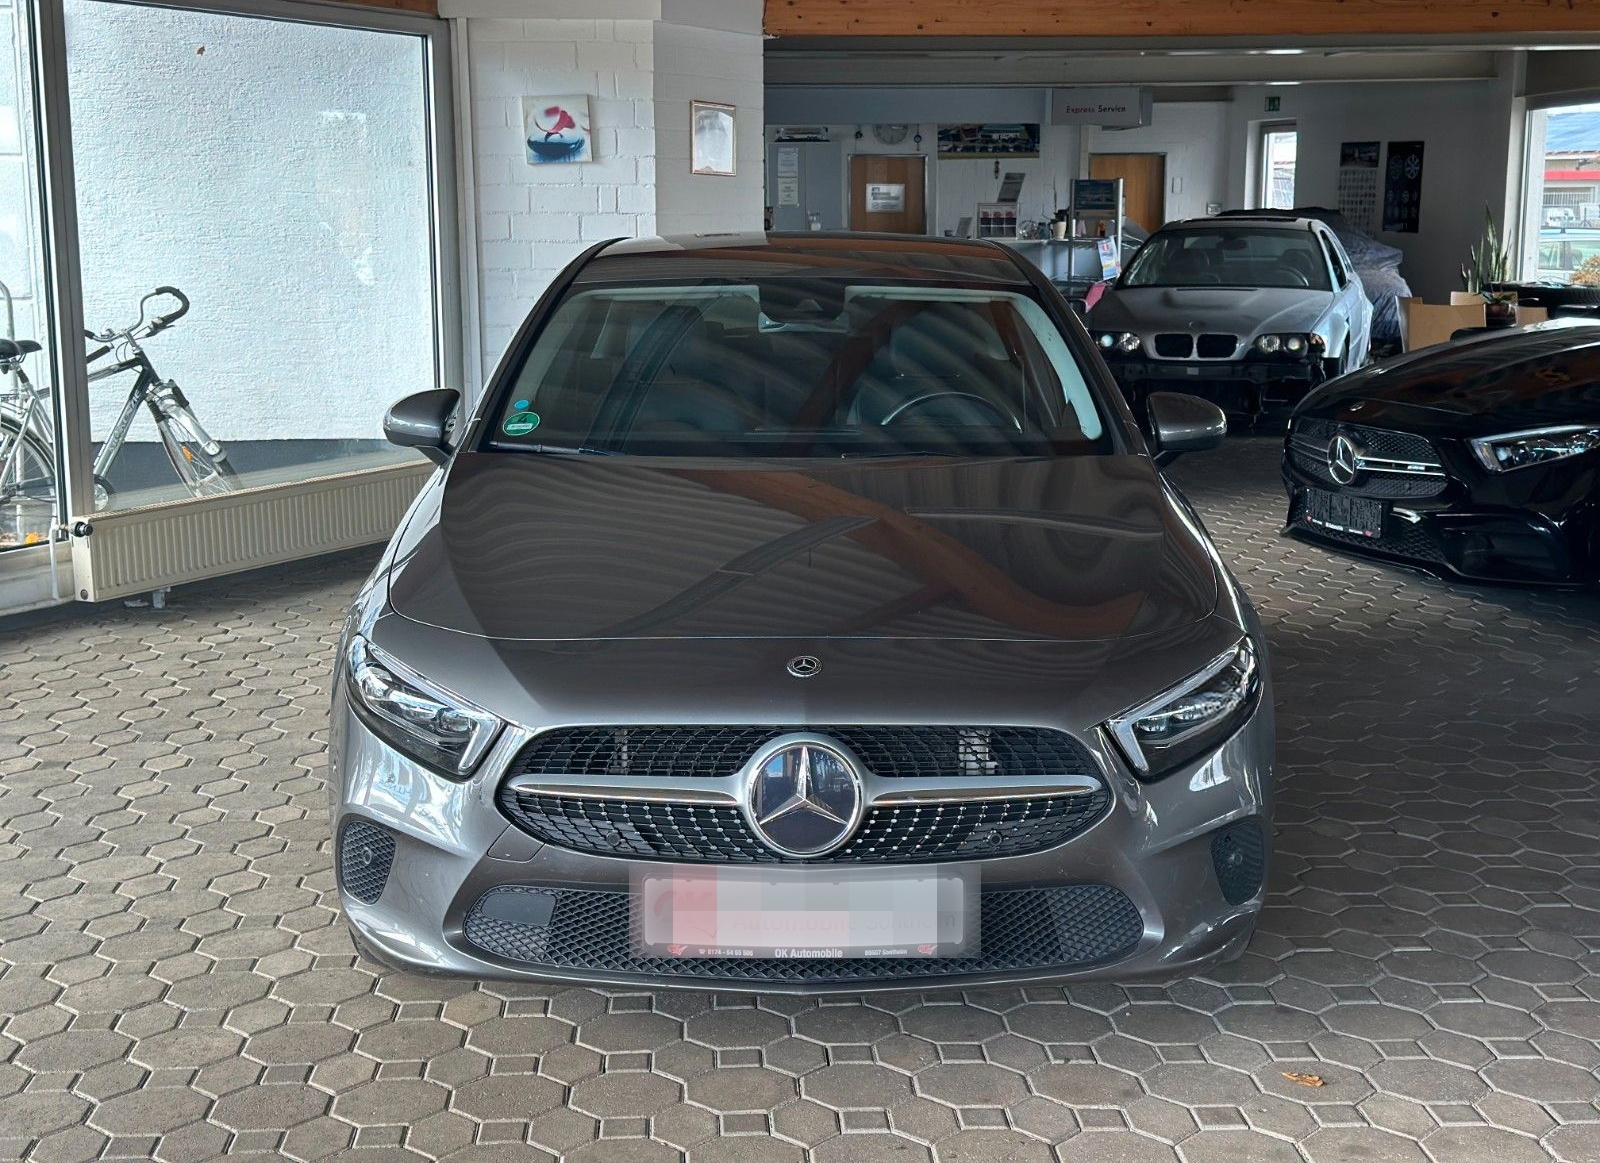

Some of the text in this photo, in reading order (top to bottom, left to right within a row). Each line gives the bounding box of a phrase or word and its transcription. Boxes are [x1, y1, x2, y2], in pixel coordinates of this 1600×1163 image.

[1066, 104, 1126, 114] Express Service
[774, 948, 843, 958] OK Automobile
[882, 948, 908, 956] Sontheim
